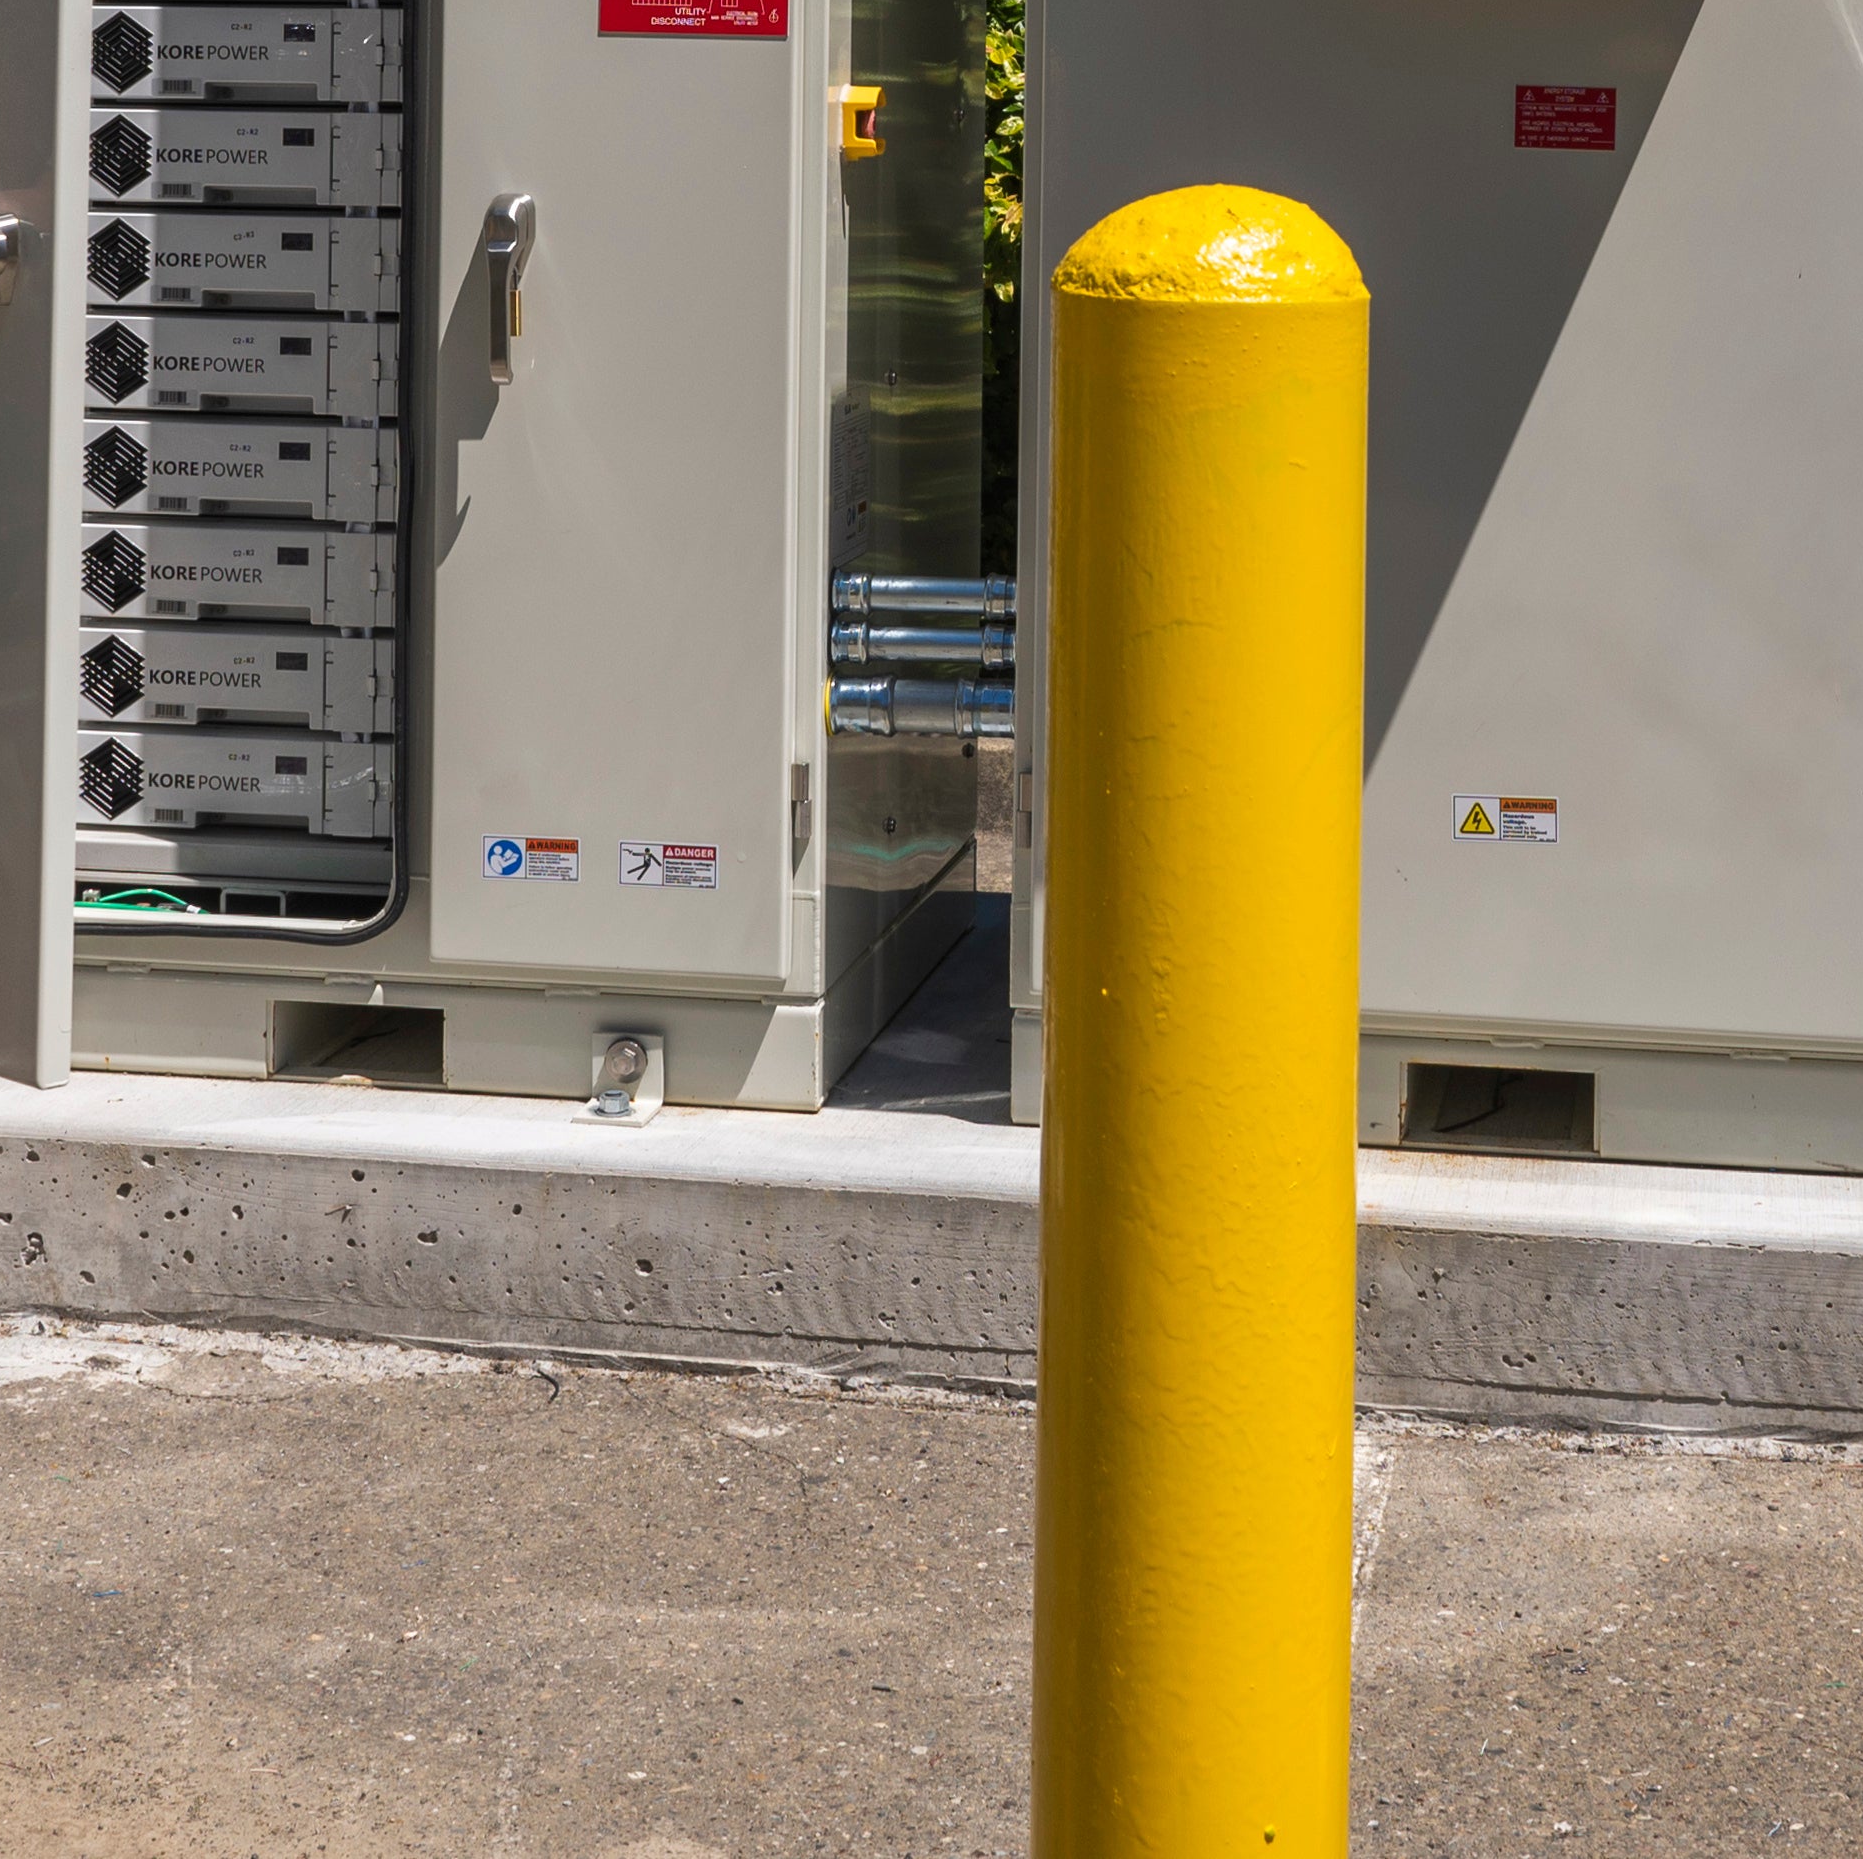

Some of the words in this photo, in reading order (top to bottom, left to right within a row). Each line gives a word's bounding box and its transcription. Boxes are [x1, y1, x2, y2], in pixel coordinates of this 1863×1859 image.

[674, 7, 708, 16] UTILITY
[650, 17, 707, 27] DISCONNECT
[536, 841, 577, 851] WARNING
[674, 847, 715, 859] DANGER
